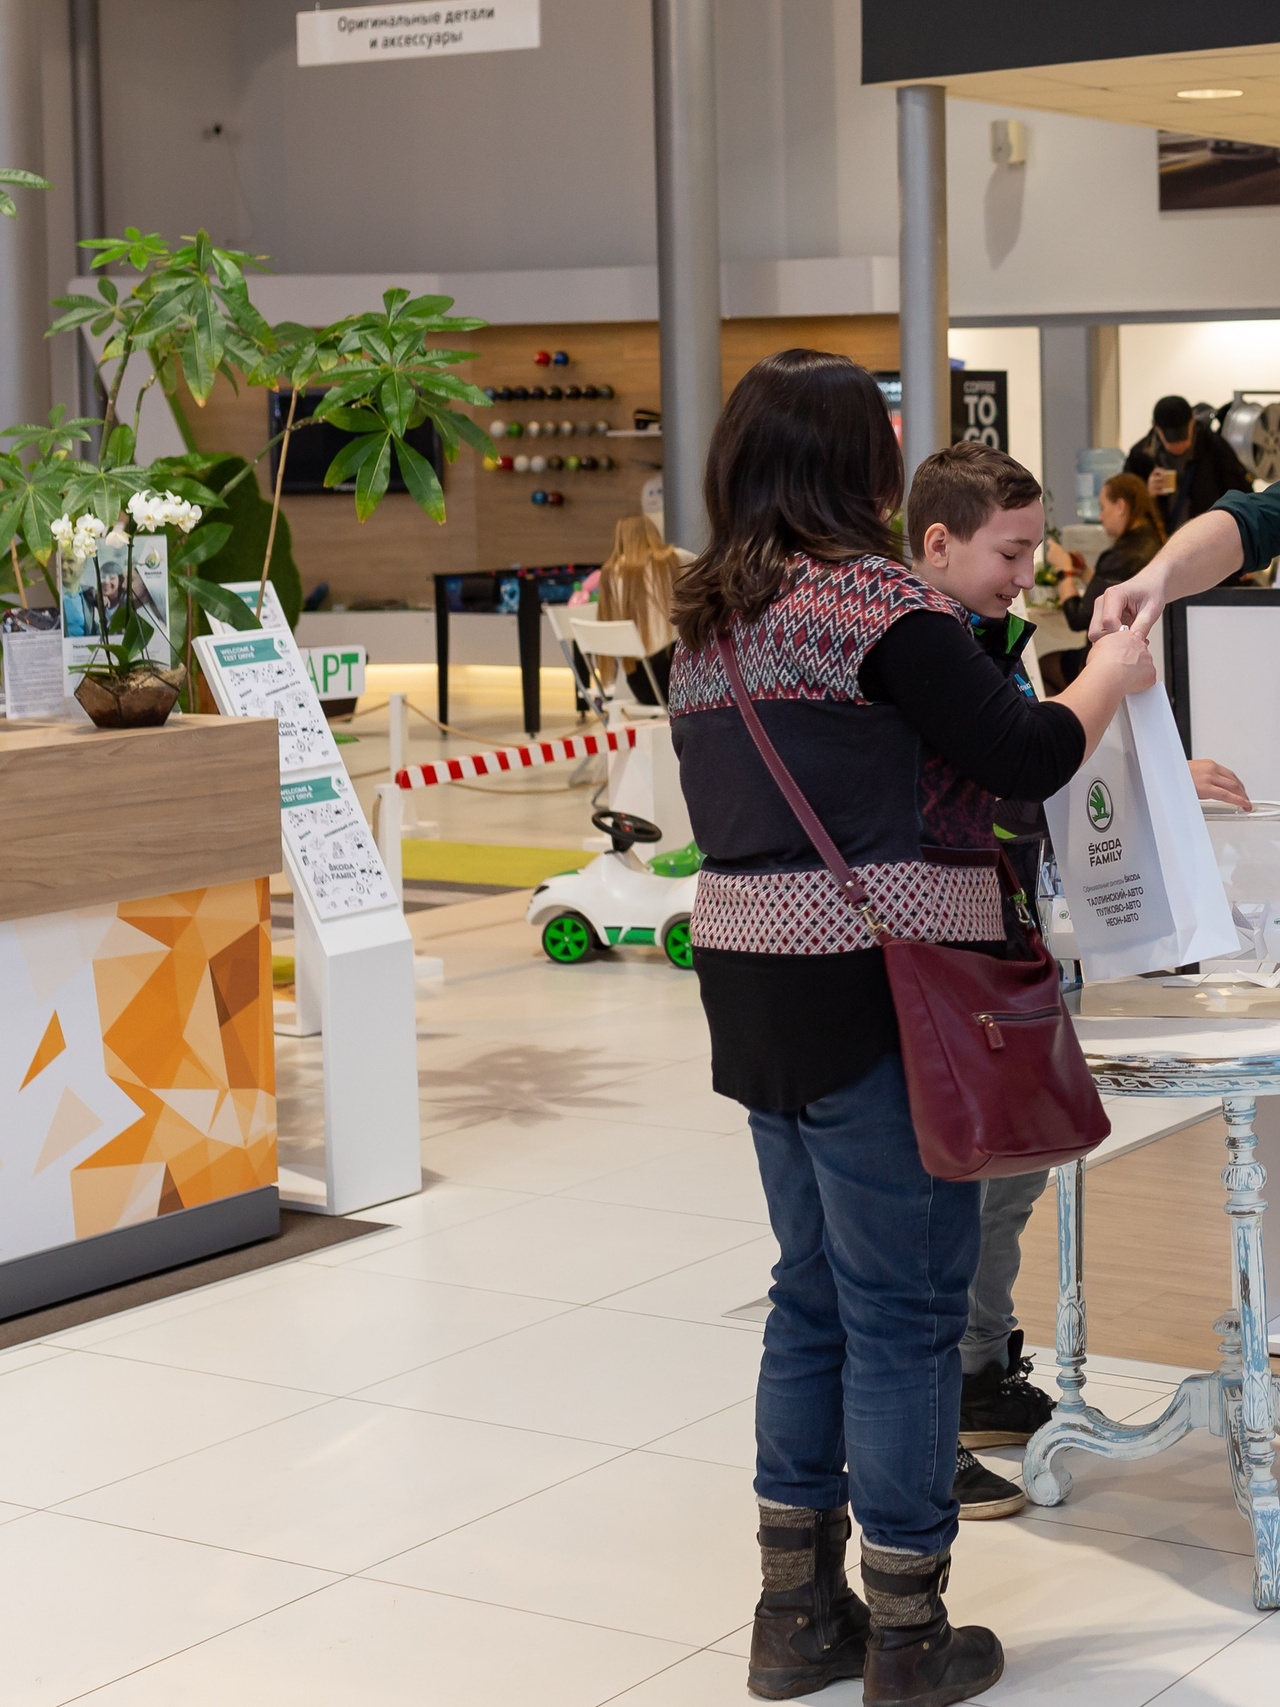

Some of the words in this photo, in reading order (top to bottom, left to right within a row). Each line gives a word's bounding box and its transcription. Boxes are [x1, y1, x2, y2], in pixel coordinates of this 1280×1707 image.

[337, 10, 441, 34] Оригинальные
[444, 7, 495, 25] детали
[369, 38, 378, 49] и
[381, 31, 463, 49] аксессуары
[963, 395, 997, 426] TO
[220, 646, 249, 656] WELCOME
[223, 654, 237, 662] TEST
[237, 652, 255, 661] DRIVE
[306, 651, 359, 694] АРТ
[282, 795, 296, 803] TEST
[295, 791, 313, 801] DRIVE
[1088, 838, 1122, 855] ŠKODA
[1089, 850, 1123, 867] FAMILY
[328, 863, 355, 872] ŠKODA
[331, 870, 357, 880] FAMILY
[1087, 886, 1144, 907] ТАЛЛИНСКИЙ-АВТО
[1096, 899, 1142, 917] ПУЛКОВО-АВТО
[1105, 912, 1139, 927] НЕОН-АВТО
